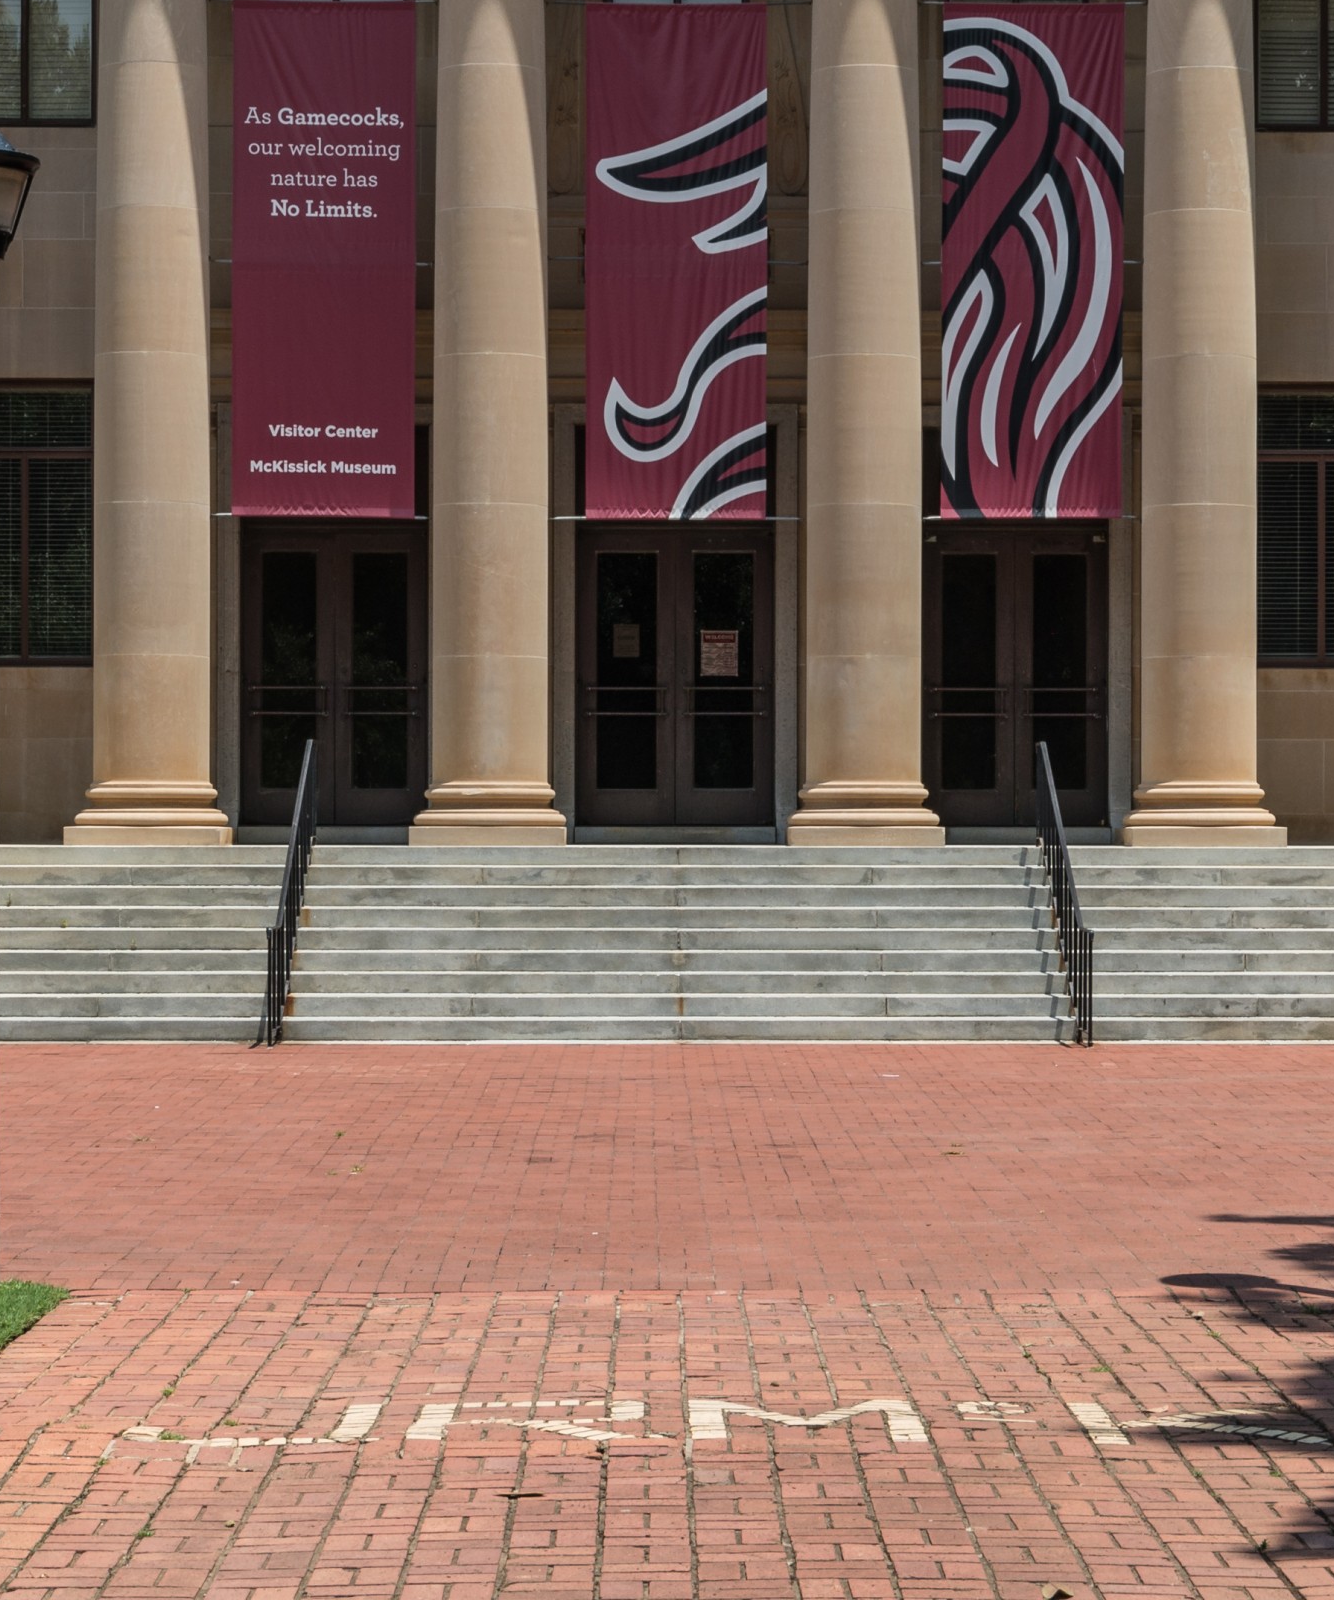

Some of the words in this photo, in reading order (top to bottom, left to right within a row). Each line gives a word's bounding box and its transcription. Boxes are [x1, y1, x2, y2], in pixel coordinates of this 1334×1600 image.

[244, 106, 271, 124] As
[277, 107, 404, 128] Gamecocks,
[248, 142, 283, 155] our
[288, 137, 401, 161] welcoming
[270, 171, 337, 187] nature
[343, 168, 378, 187] has
[270, 199, 300, 217] No
[305, 199, 378, 218] Limits.
[268, 424, 321, 438] Visitor
[325, 425, 378, 439] Center
[250, 460, 327, 474] McKissick
[330, 461, 397, 475] Museum
